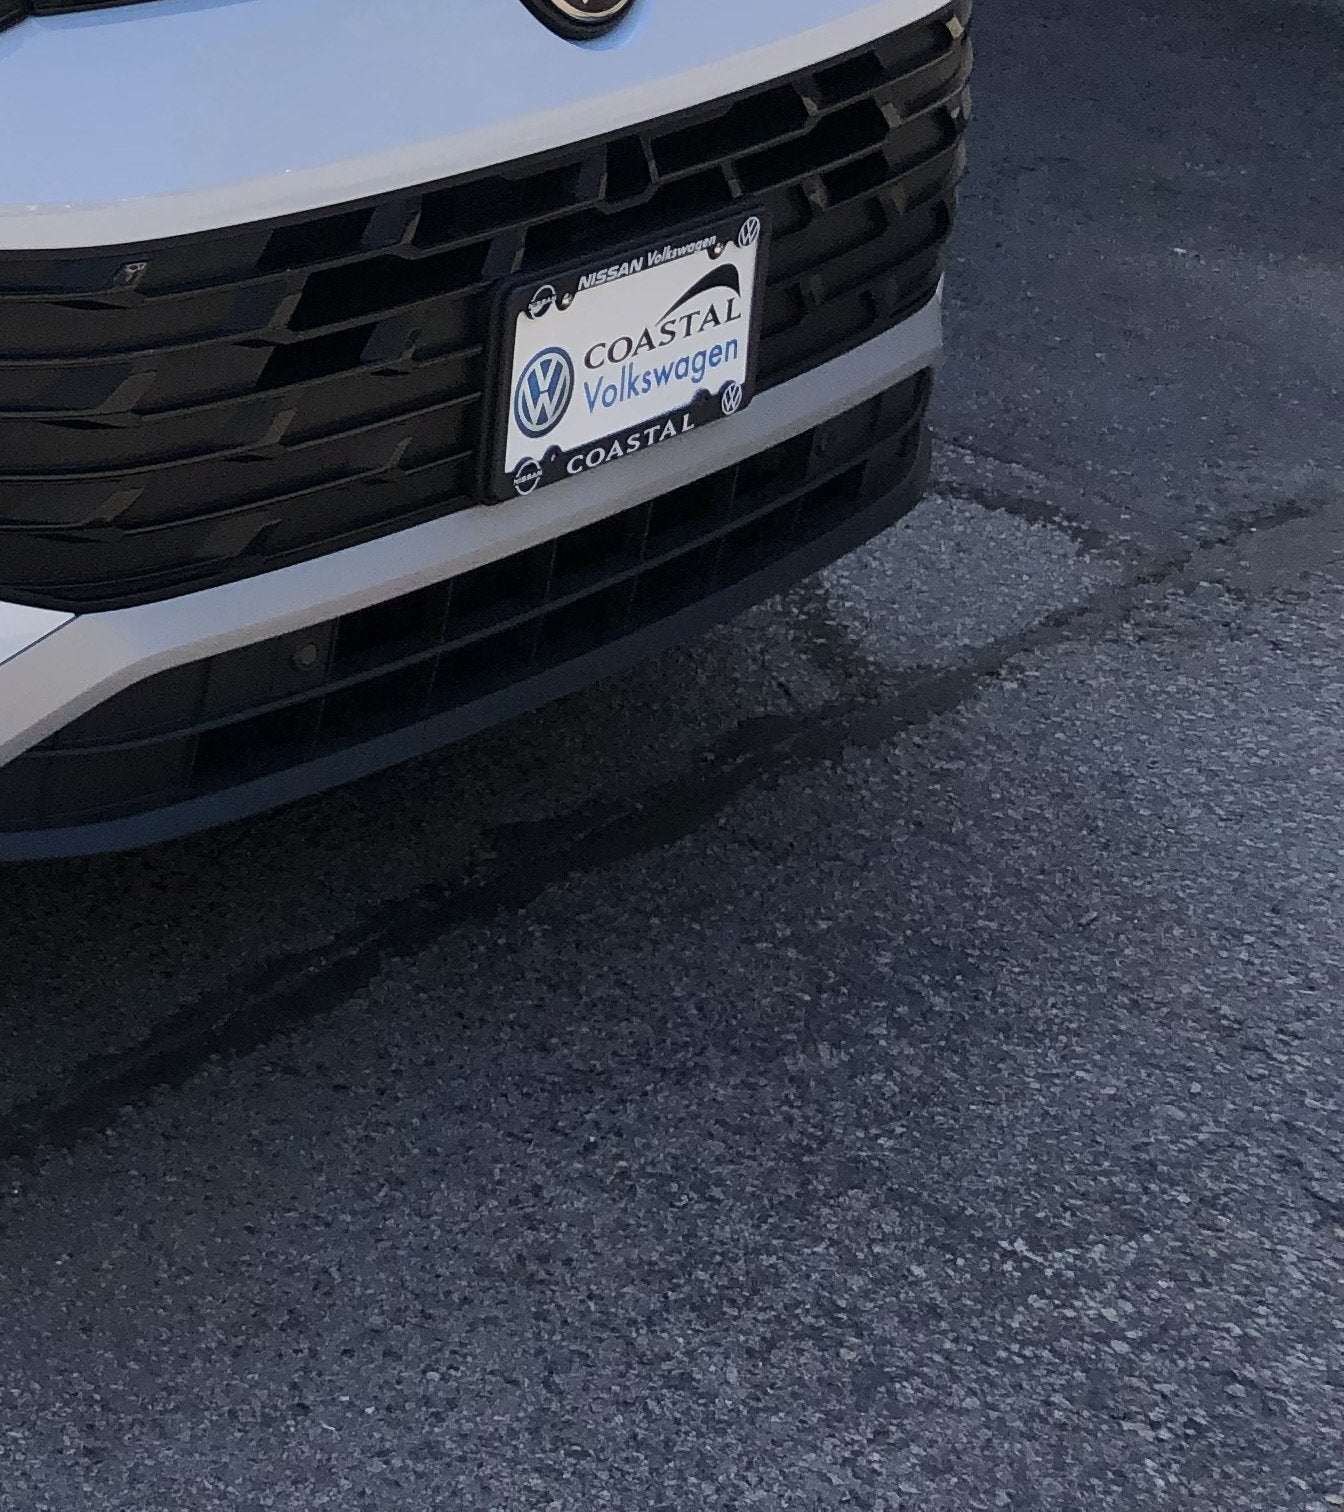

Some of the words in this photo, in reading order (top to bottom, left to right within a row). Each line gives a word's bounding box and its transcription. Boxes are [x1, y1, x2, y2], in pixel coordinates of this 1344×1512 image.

[578, 256, 643, 291] NISSAN
[647, 236, 717, 267] Volkswagen
[583, 297, 742, 370] COASTAL
[583, 338, 739, 414] Volkswagen
[566, 413, 696, 475] COASTAL
